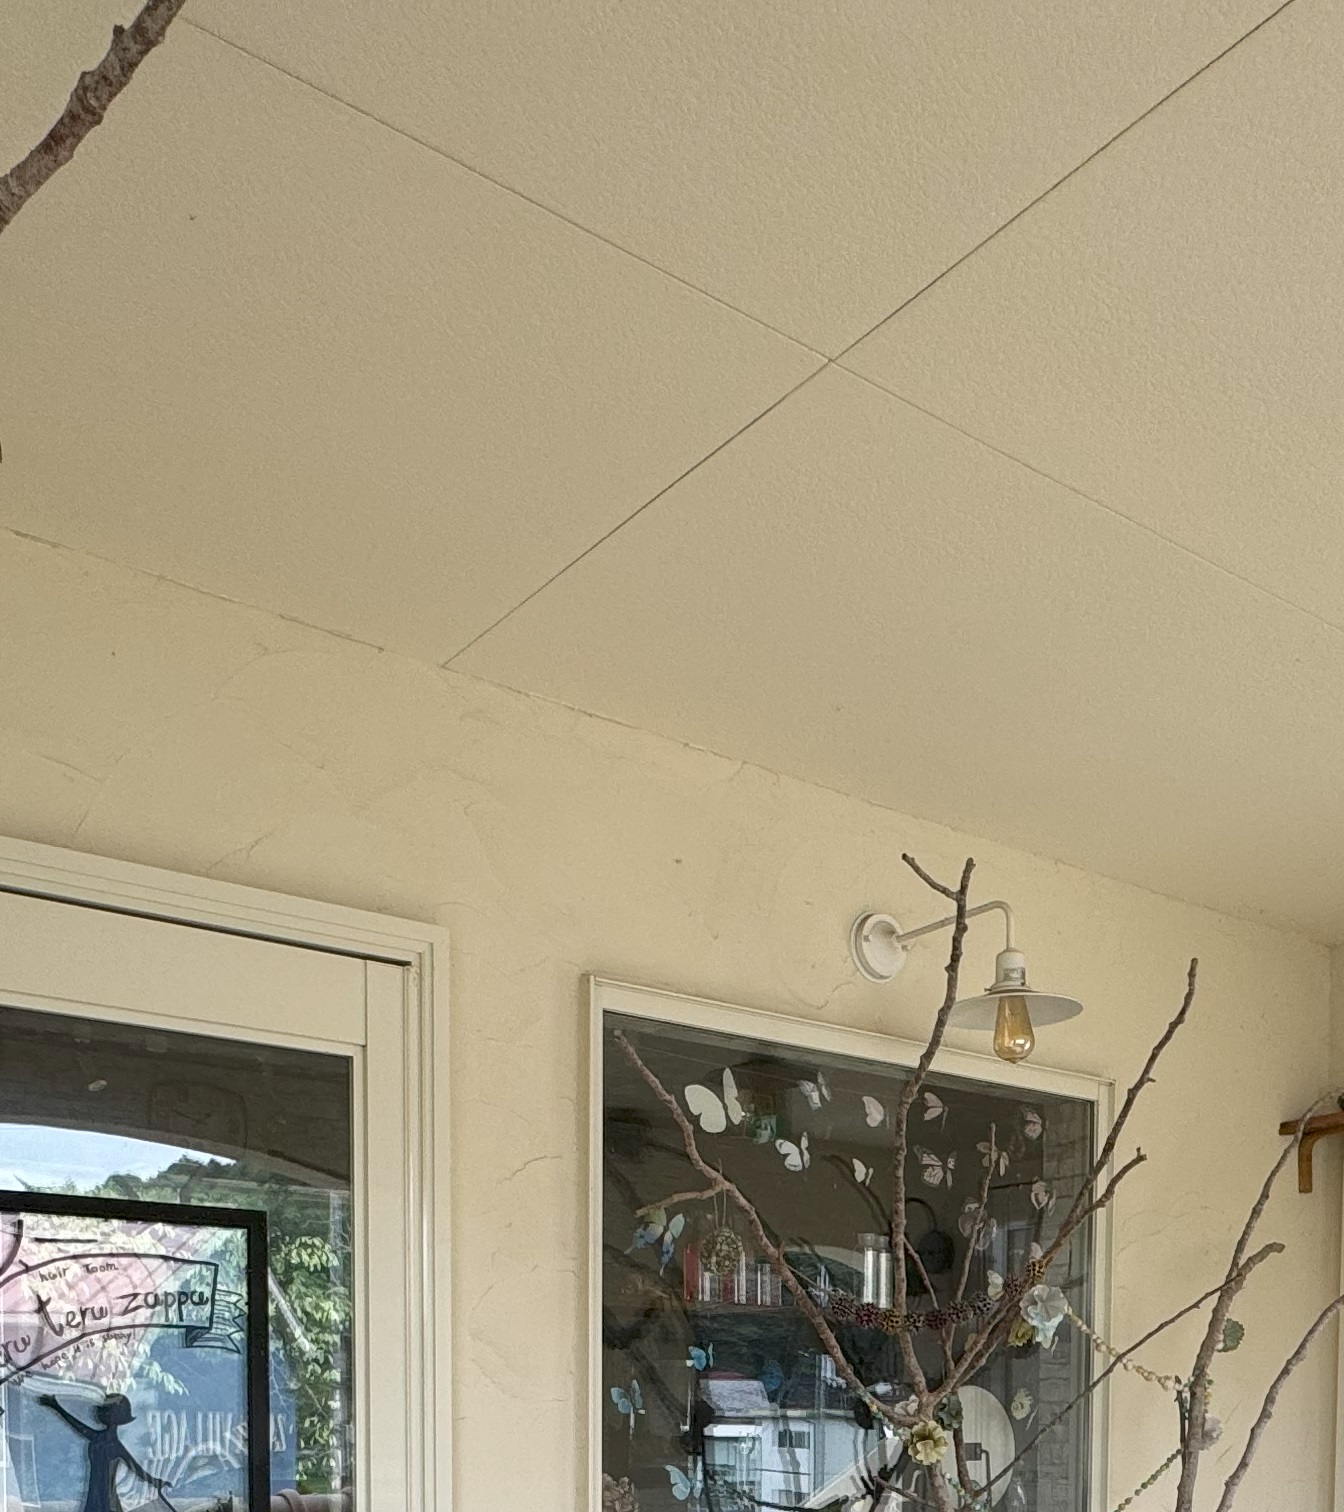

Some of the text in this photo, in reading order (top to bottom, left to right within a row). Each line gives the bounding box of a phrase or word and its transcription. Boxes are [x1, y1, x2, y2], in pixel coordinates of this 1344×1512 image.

[39, 1267, 67, 1281] hair
[35, 1293, 109, 1337] teru
[114, 1290, 210, 1323] zappa
